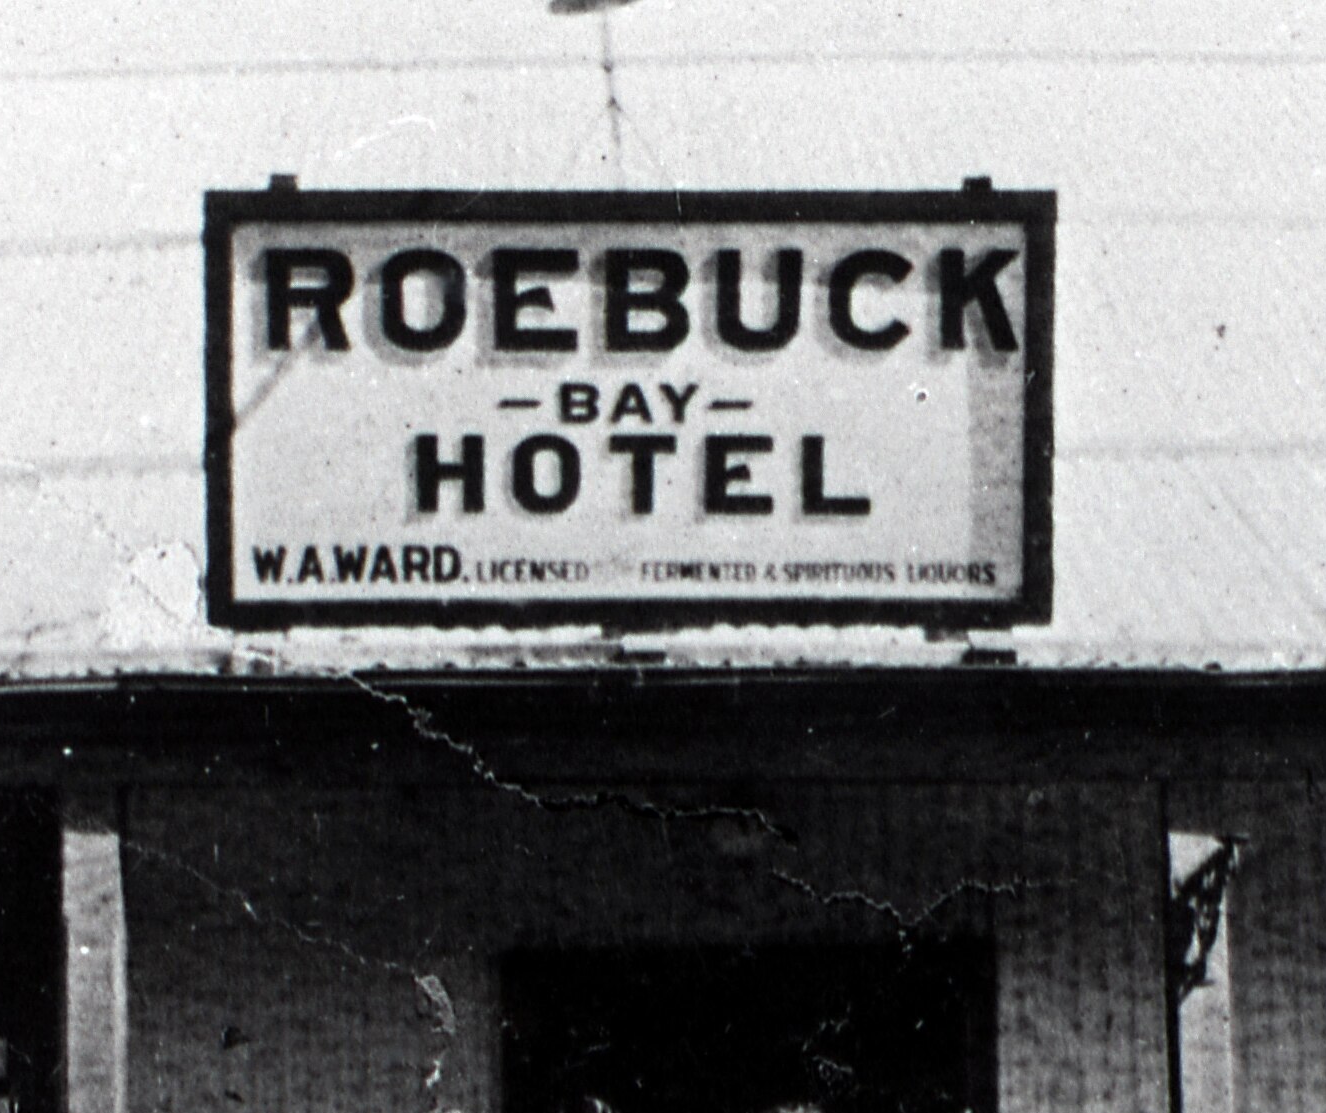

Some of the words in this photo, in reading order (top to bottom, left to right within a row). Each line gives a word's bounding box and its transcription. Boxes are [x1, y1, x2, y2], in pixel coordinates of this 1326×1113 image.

[261, 246, 1019, 353] ROEBUCK
[414, 433, 871, 515] HOTEL
[475, 557, 589, 583] LICENSED
[906, 562, 997, 585] LIQUORS
